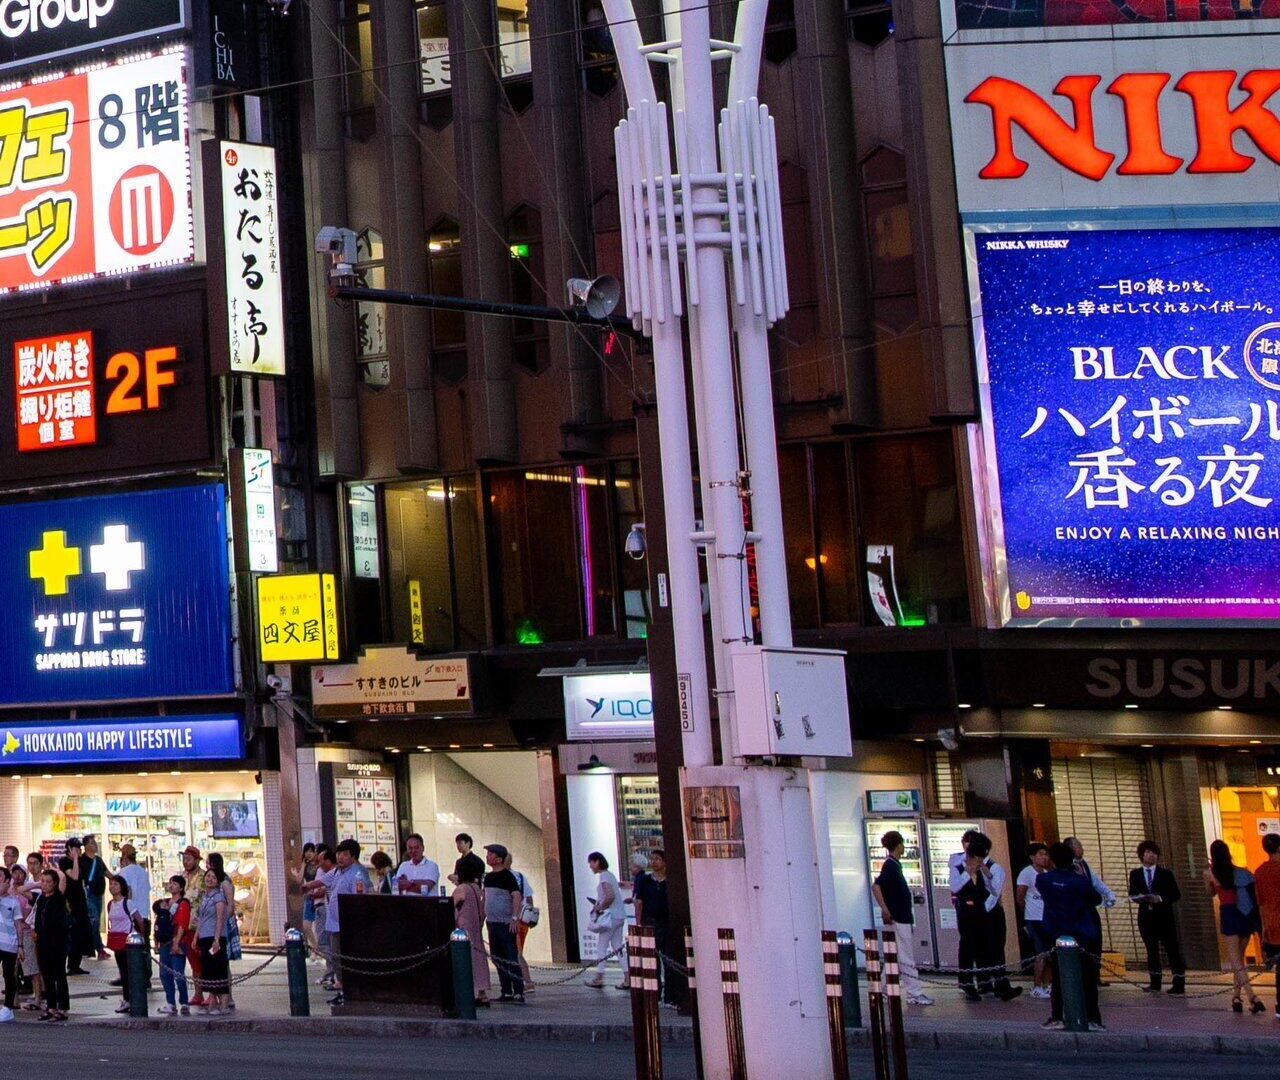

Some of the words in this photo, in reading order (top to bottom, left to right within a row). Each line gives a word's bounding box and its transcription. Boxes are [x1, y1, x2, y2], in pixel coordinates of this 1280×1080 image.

[98, 82, 181, 151] 8階
[963, 69, 1280, 182] NIK
[986, 240, 1026, 251] NIKKA
[1026, 239, 1069, 250] WHISKY
[1099, 279, 1211, 294] 一日の終わりを、
[1030, 299, 1273, 316] ちょっと幸せにしてくれるハイボール。
[18, 340, 92, 386] 炭火焼き
[1070, 345, 1239, 380] BLACK
[106, 347, 179, 415] 2F
[39, 420, 76, 443] 個室
[1020, 395, 1280, 444] ハイボール
[1065, 445, 1273, 509] 香る夜
[1056, 526, 1112, 540] ENJOY
[1119, 527, 1131, 539] A
[1138, 526, 1226, 539] RELAXING
[263, 618, 321, 645] 四文屋
[36, 651, 80, 671] SAPPORO
[82, 650, 109, 668] DRUG
[111, 648, 145, 666] STORE
[355, 674, 421, 690] すすきのビル
[1085, 658, 1280, 699] SUSUK
[679, 681, 689, 731] 90450
[23, 732, 83, 753] HOKKAIDO
[87, 730, 125, 751] HAPPY
[129, 727, 193, 750] LIFESTYLE
